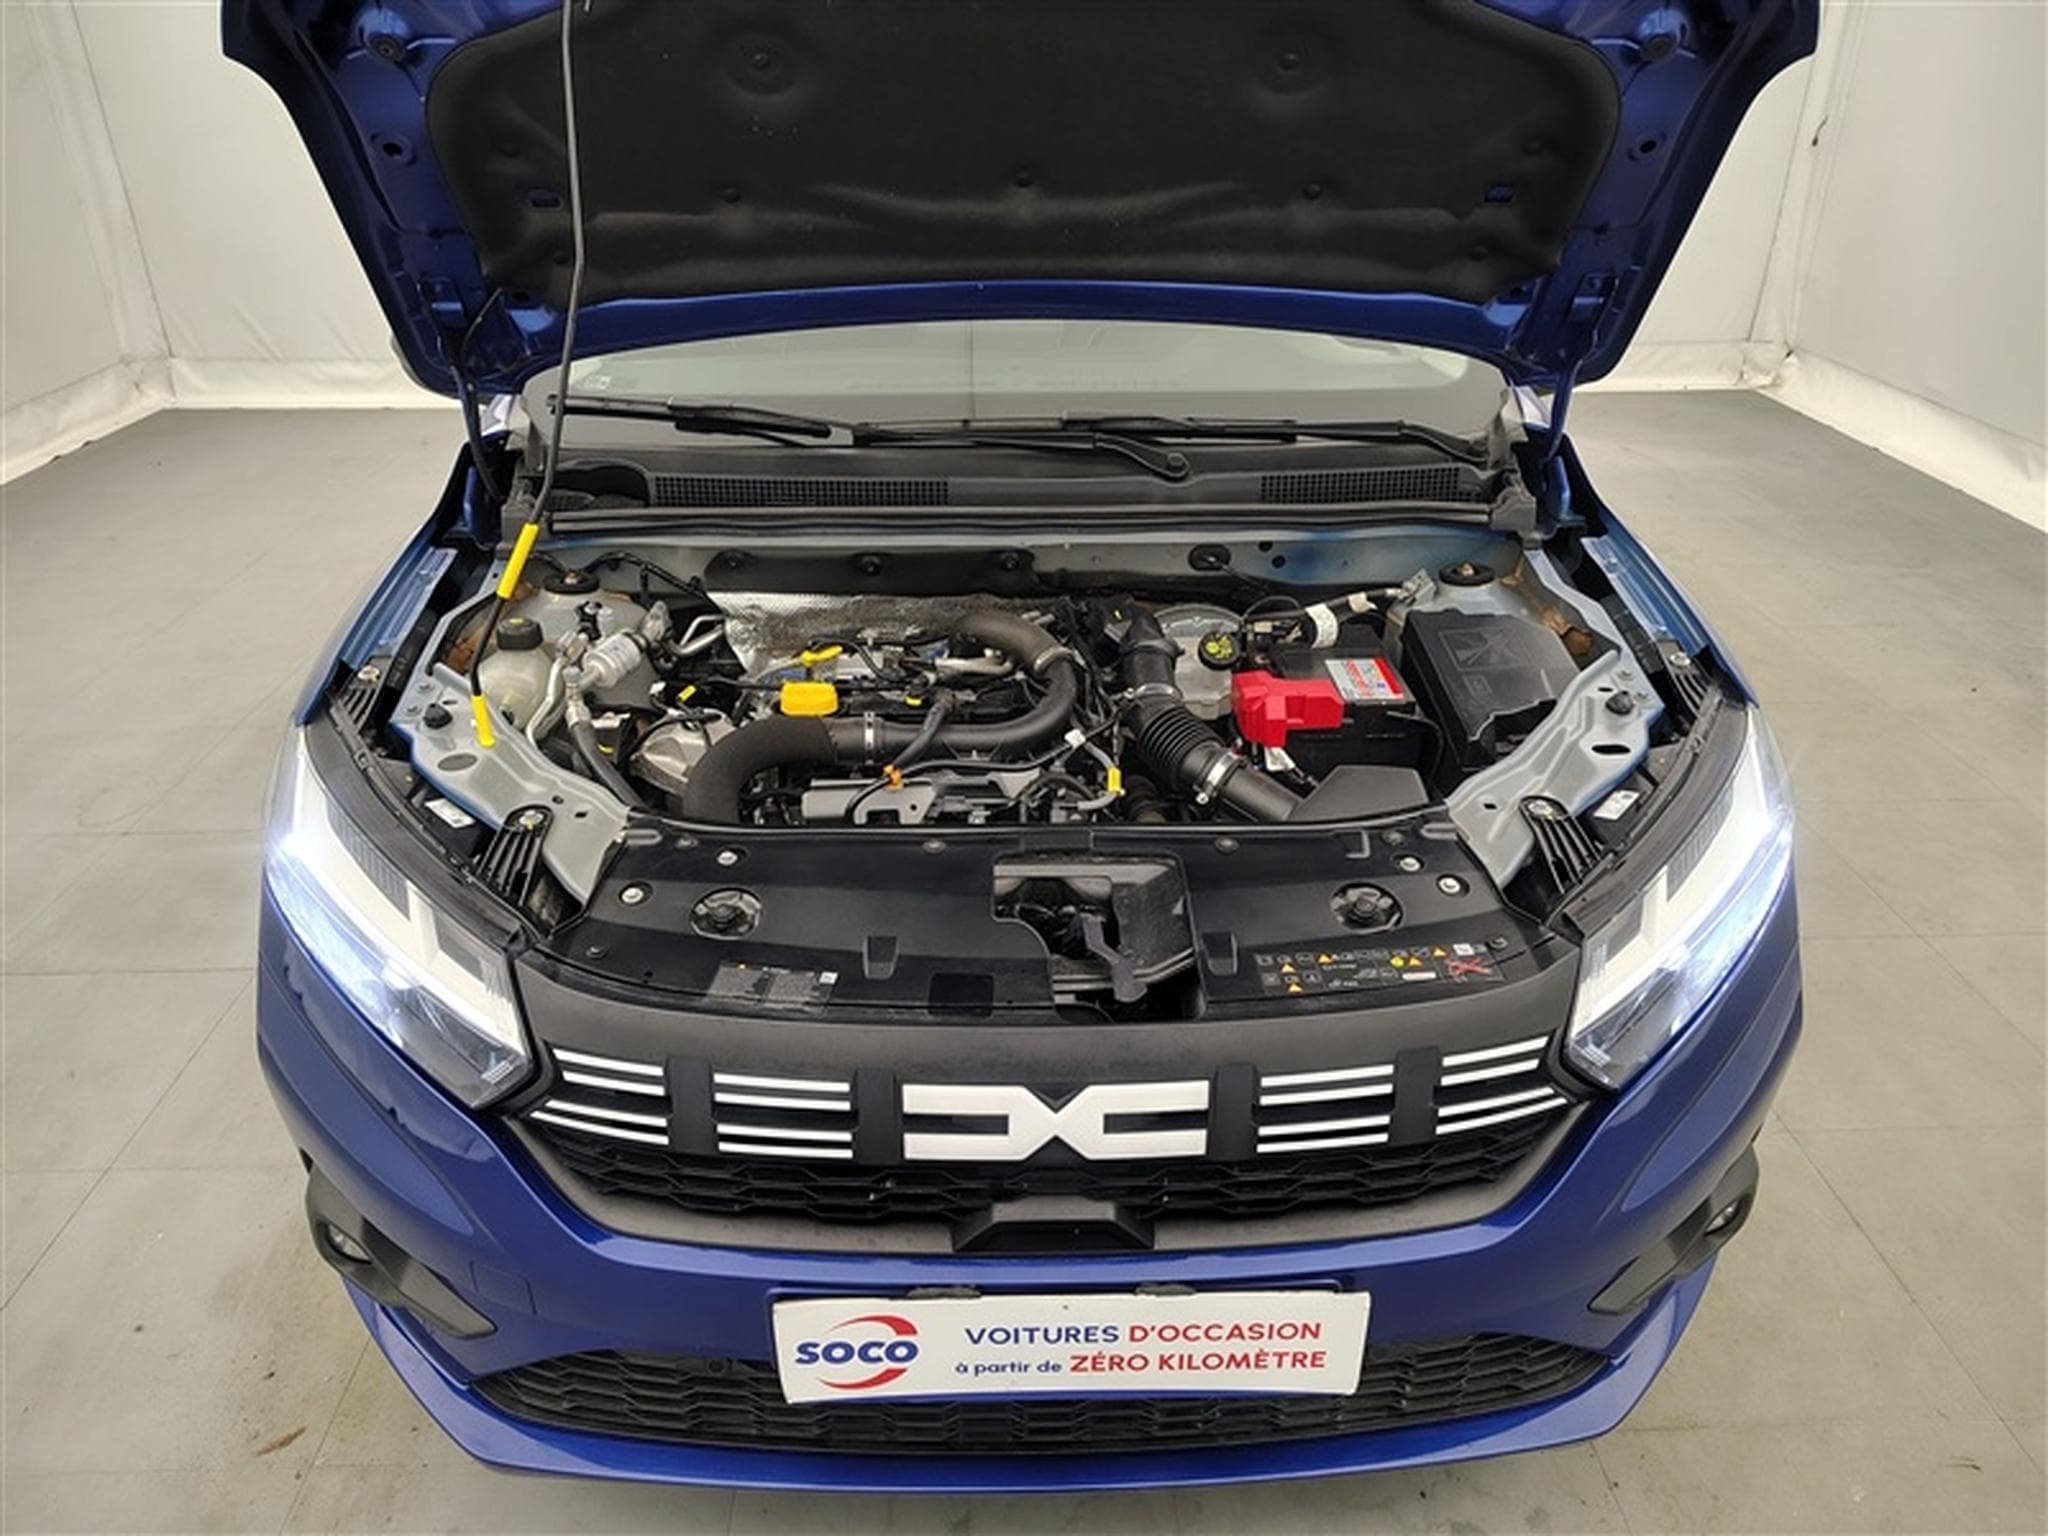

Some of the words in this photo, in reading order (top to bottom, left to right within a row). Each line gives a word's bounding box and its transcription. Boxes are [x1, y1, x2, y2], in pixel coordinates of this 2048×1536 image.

[964, 1325, 1120, 1345] VOITURES
[1128, 1322, 1322, 1343] D'OCCASION
[793, 1339, 920, 1365] SOCO
[955, 1361, 969, 1374] à
[974, 1359, 1032, 1377] partir
[1037, 1359, 1062, 1373] de
[1069, 1351, 1150, 1373] ZÉRO
[1158, 1348, 1327, 1371] KILOMÈTRE
